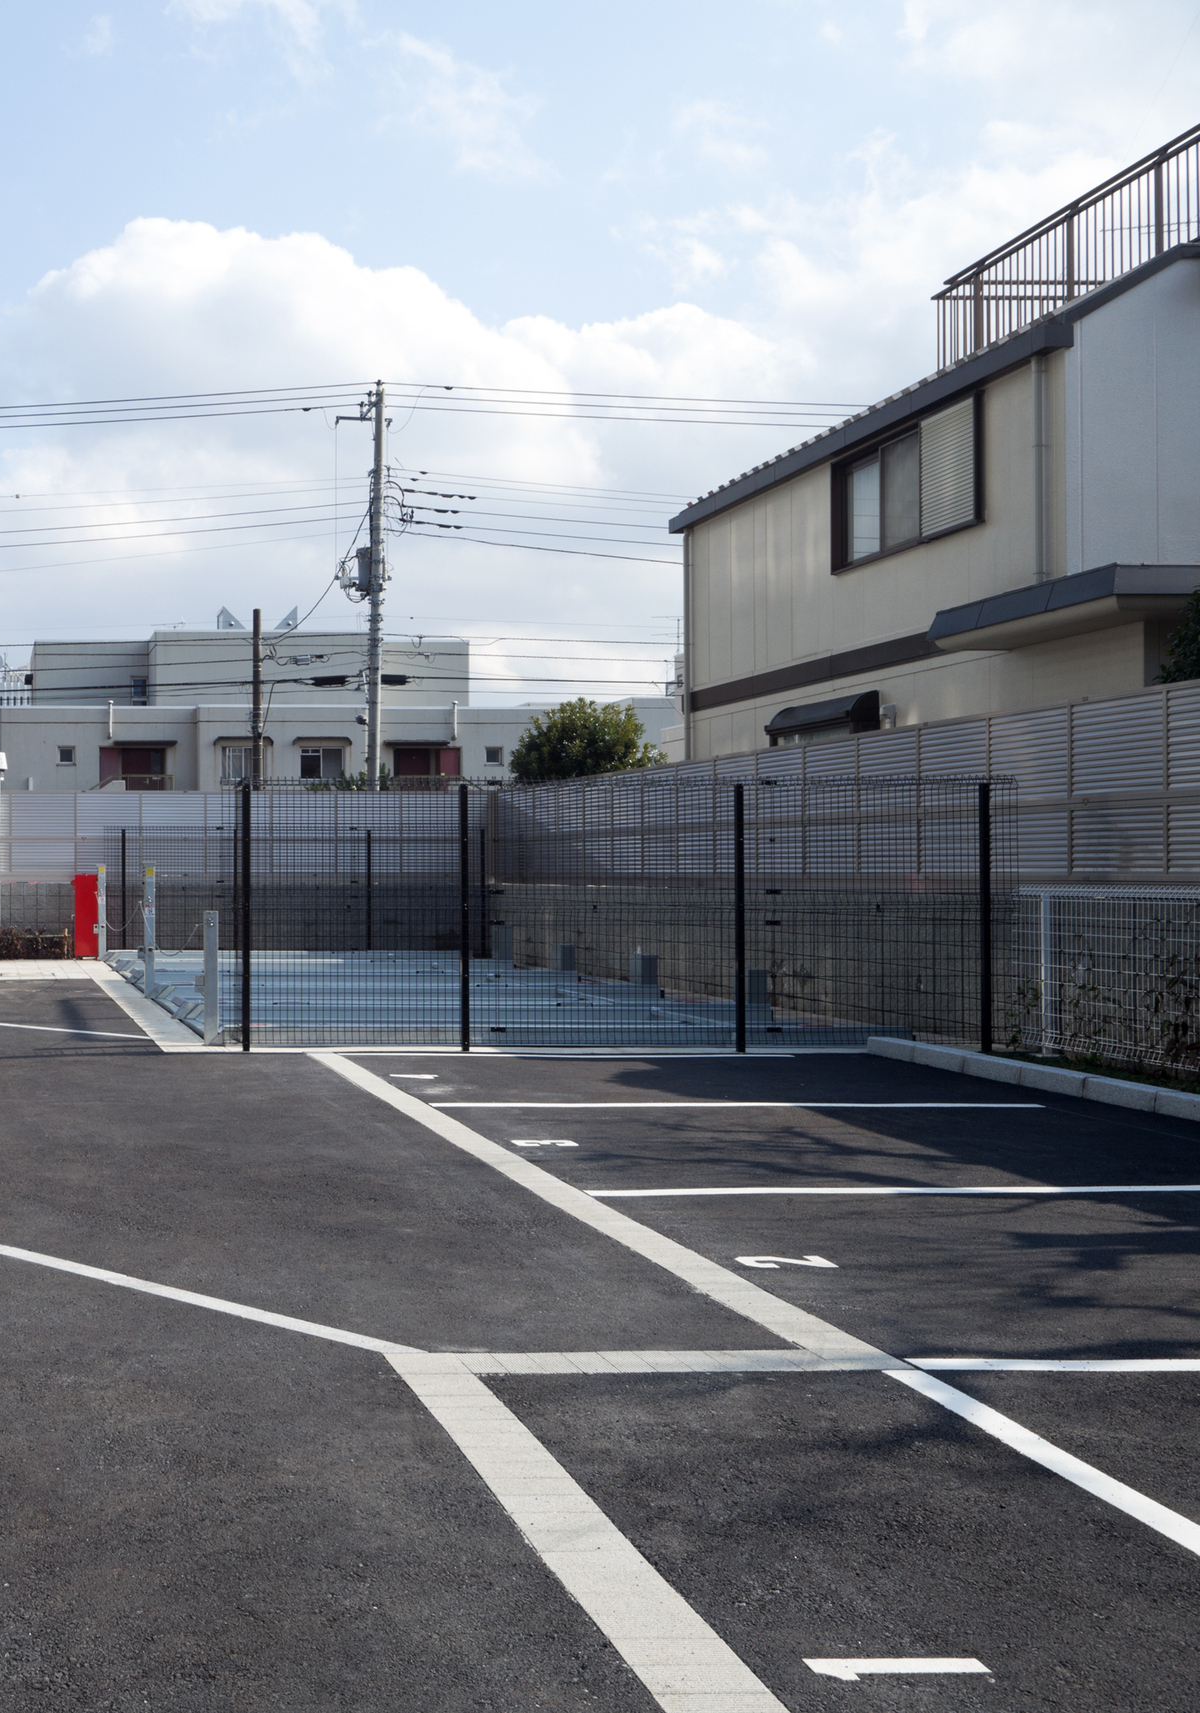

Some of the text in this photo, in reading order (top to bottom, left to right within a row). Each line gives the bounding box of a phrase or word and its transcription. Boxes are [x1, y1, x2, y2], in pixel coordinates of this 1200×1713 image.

[510, 1139, 579, 1147] 3
[734, 1255, 840, 1268] 2
[801, 1657, 992, 1681] 1
